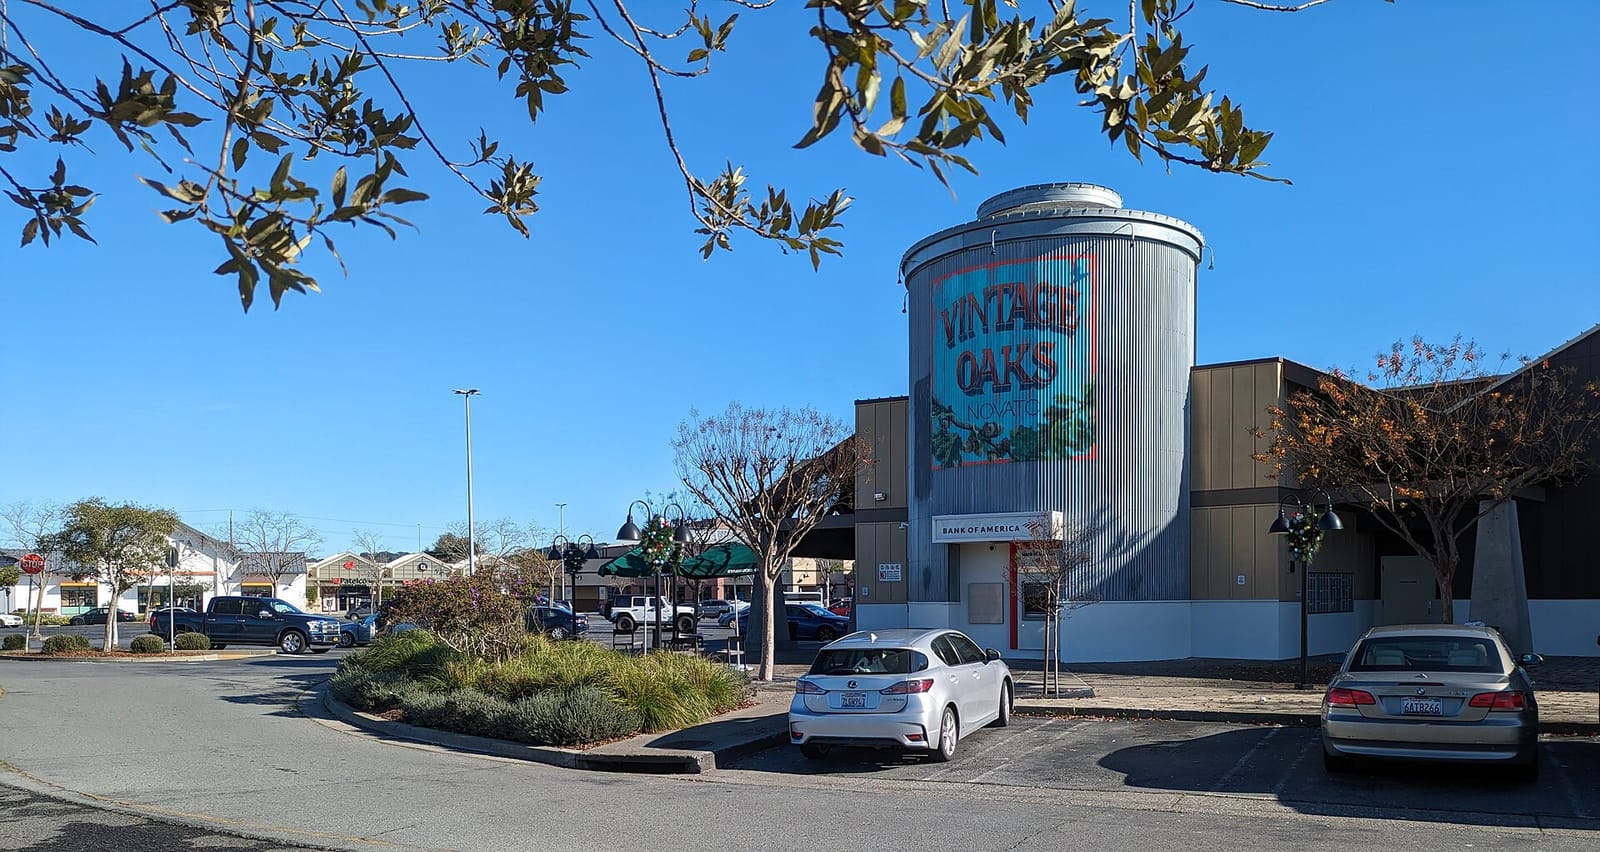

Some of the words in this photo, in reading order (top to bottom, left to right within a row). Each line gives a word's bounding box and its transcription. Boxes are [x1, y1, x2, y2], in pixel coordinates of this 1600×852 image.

[941, 282, 1081, 348] VINTAGE
[956, 341, 1057, 396] OAKS
[967, 400, 1039, 420] NOVATO
[23, 560, 44, 568] STOP
[1404, 702, 1440, 713] 6ATB266
